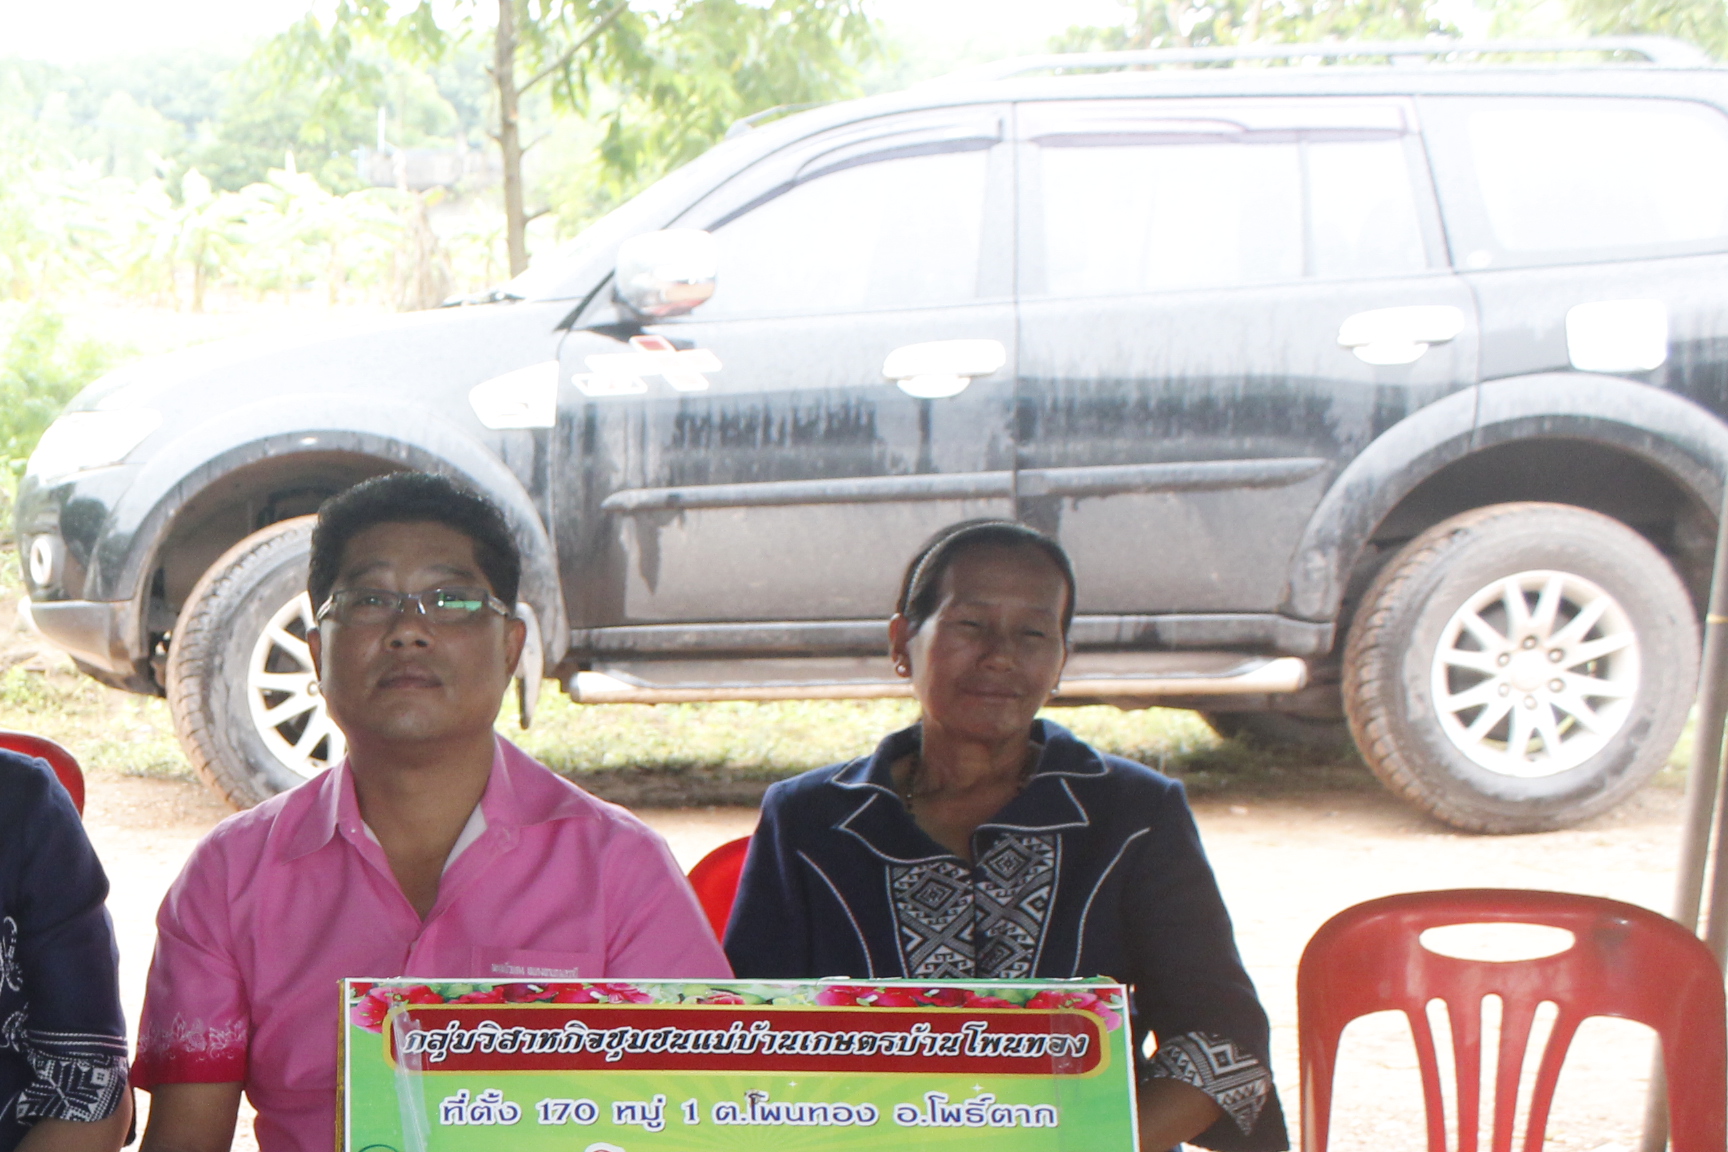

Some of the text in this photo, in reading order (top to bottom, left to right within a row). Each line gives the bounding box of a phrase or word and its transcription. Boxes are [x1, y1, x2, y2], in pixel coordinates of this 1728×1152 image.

[405, 1020, 1089, 1062] กลุ่มวิสาหกิจชุมชนแม่บ้านเกษตรบ้านโพนทอง
[443, 1090, 1057, 1129] ที่ตั้ง 170 หมู่ 1 ต.โพนทอง อ.โพธิ์ตาก
